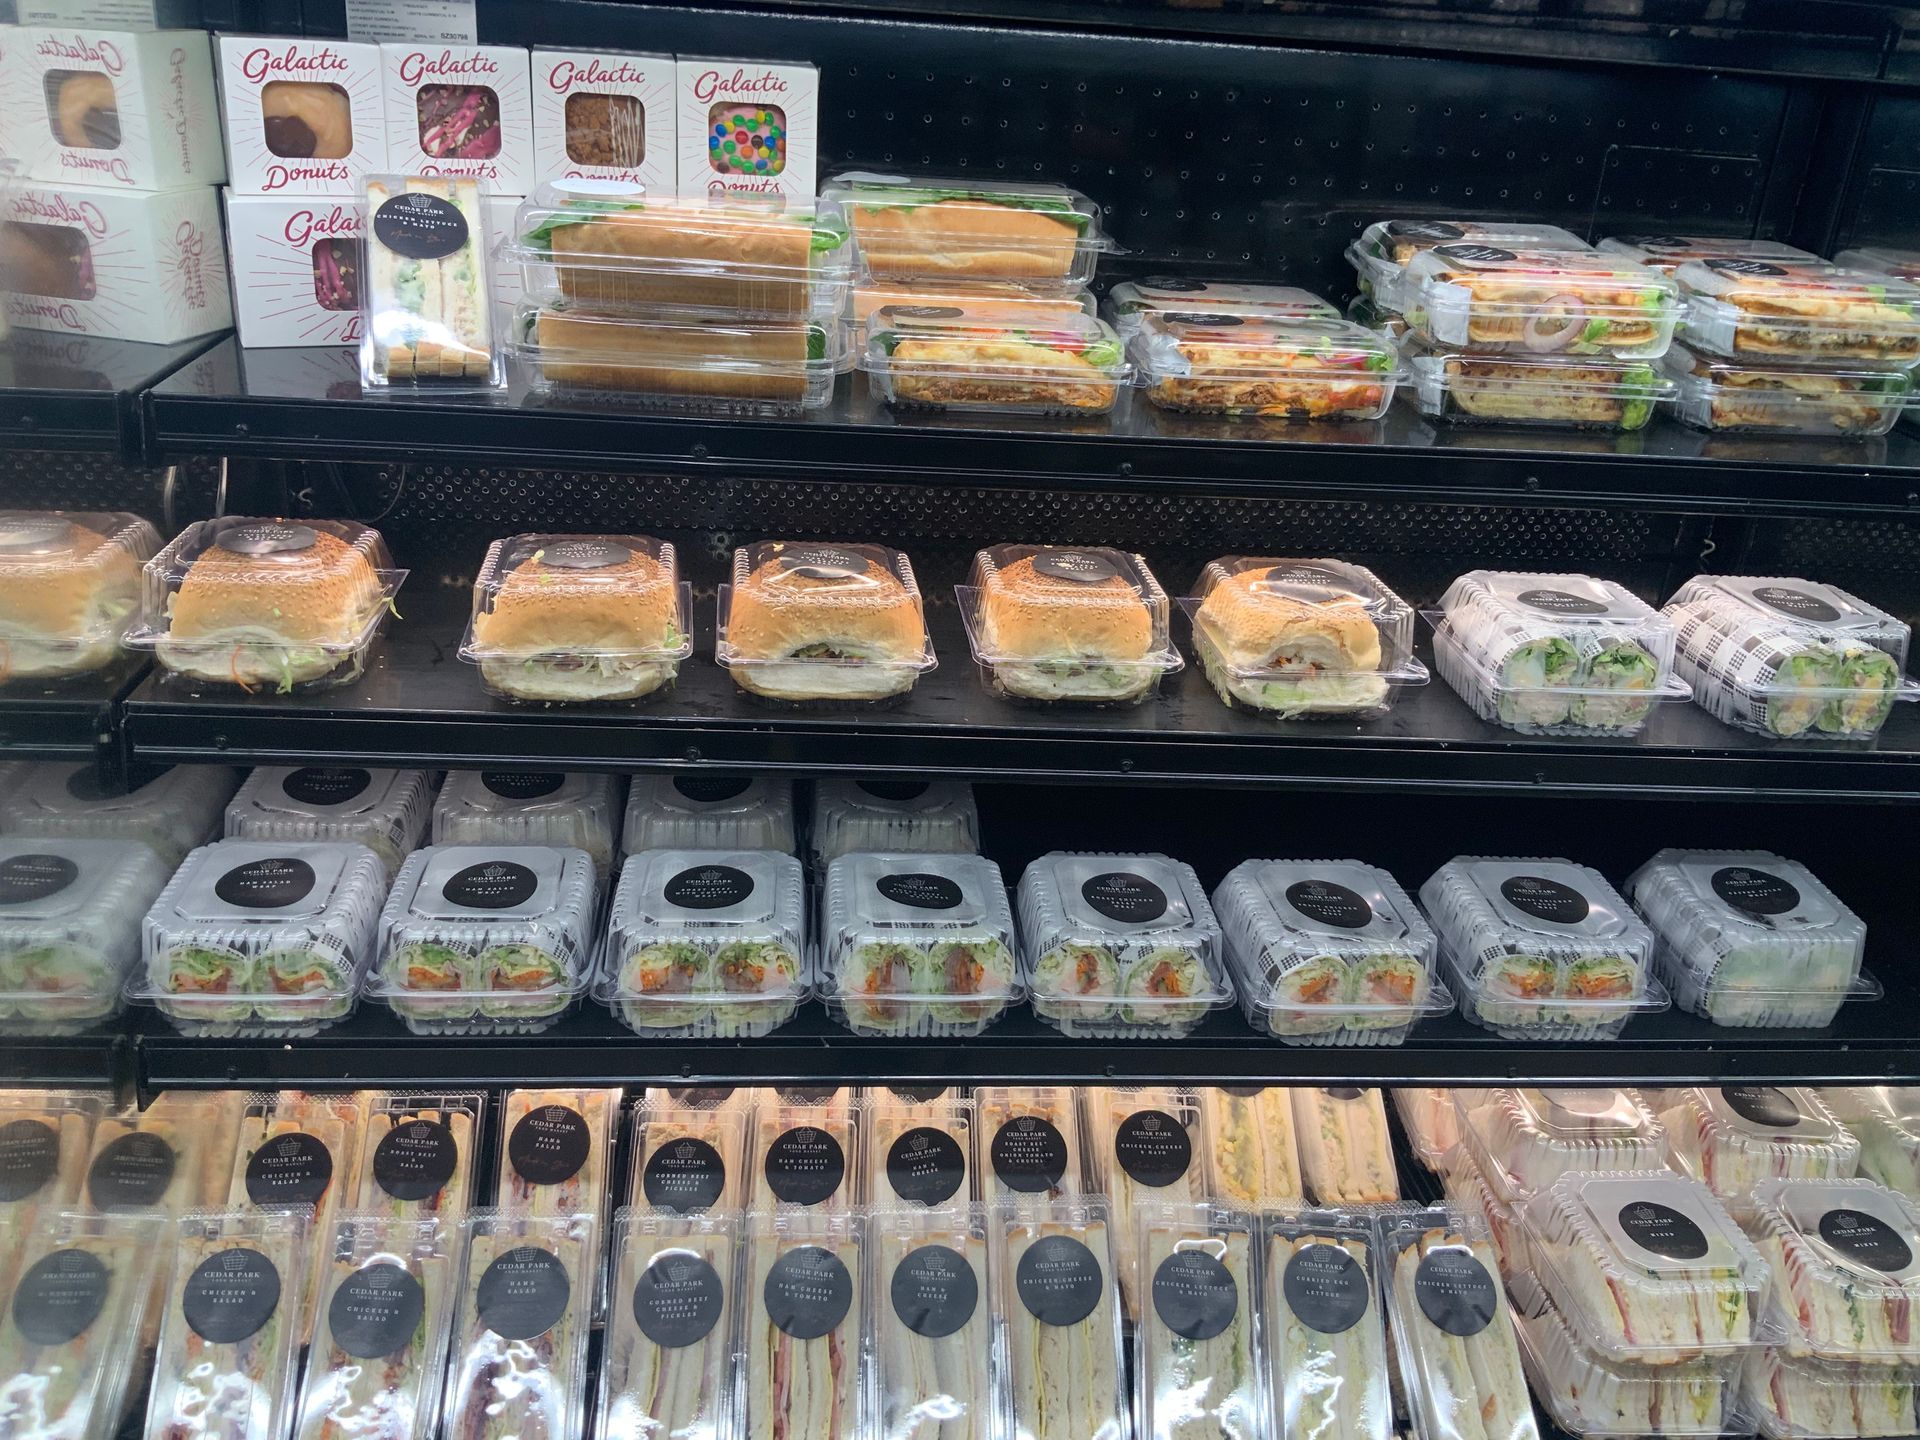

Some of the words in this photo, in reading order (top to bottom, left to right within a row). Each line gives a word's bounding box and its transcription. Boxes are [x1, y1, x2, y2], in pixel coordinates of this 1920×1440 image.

[243, 45, 348, 83] Galactic
[400, 50, 498, 87] Galactic
[550, 60, 645, 94] Galactic
[695, 69, 788, 104] Galactic
[262, 162, 348, 191] Donuts
[421, 219, 457, 227] LETTUCE
[530, 1120, 553, 1128] CEDAR
[901, 1151, 922, 1159] CEDAR
[924, 1147, 942, 1155] PARK
[912, 1168, 938, 1176] CHEESE
[786, 1267, 811, 1275] CEDAR
[937, 1270, 956, 1278] PARK
[350, 1288, 378, 1296] CEDAR
[794, 1293, 828, 1301] TOMATO
[347, 1306, 389, 1314] CHICKEN
